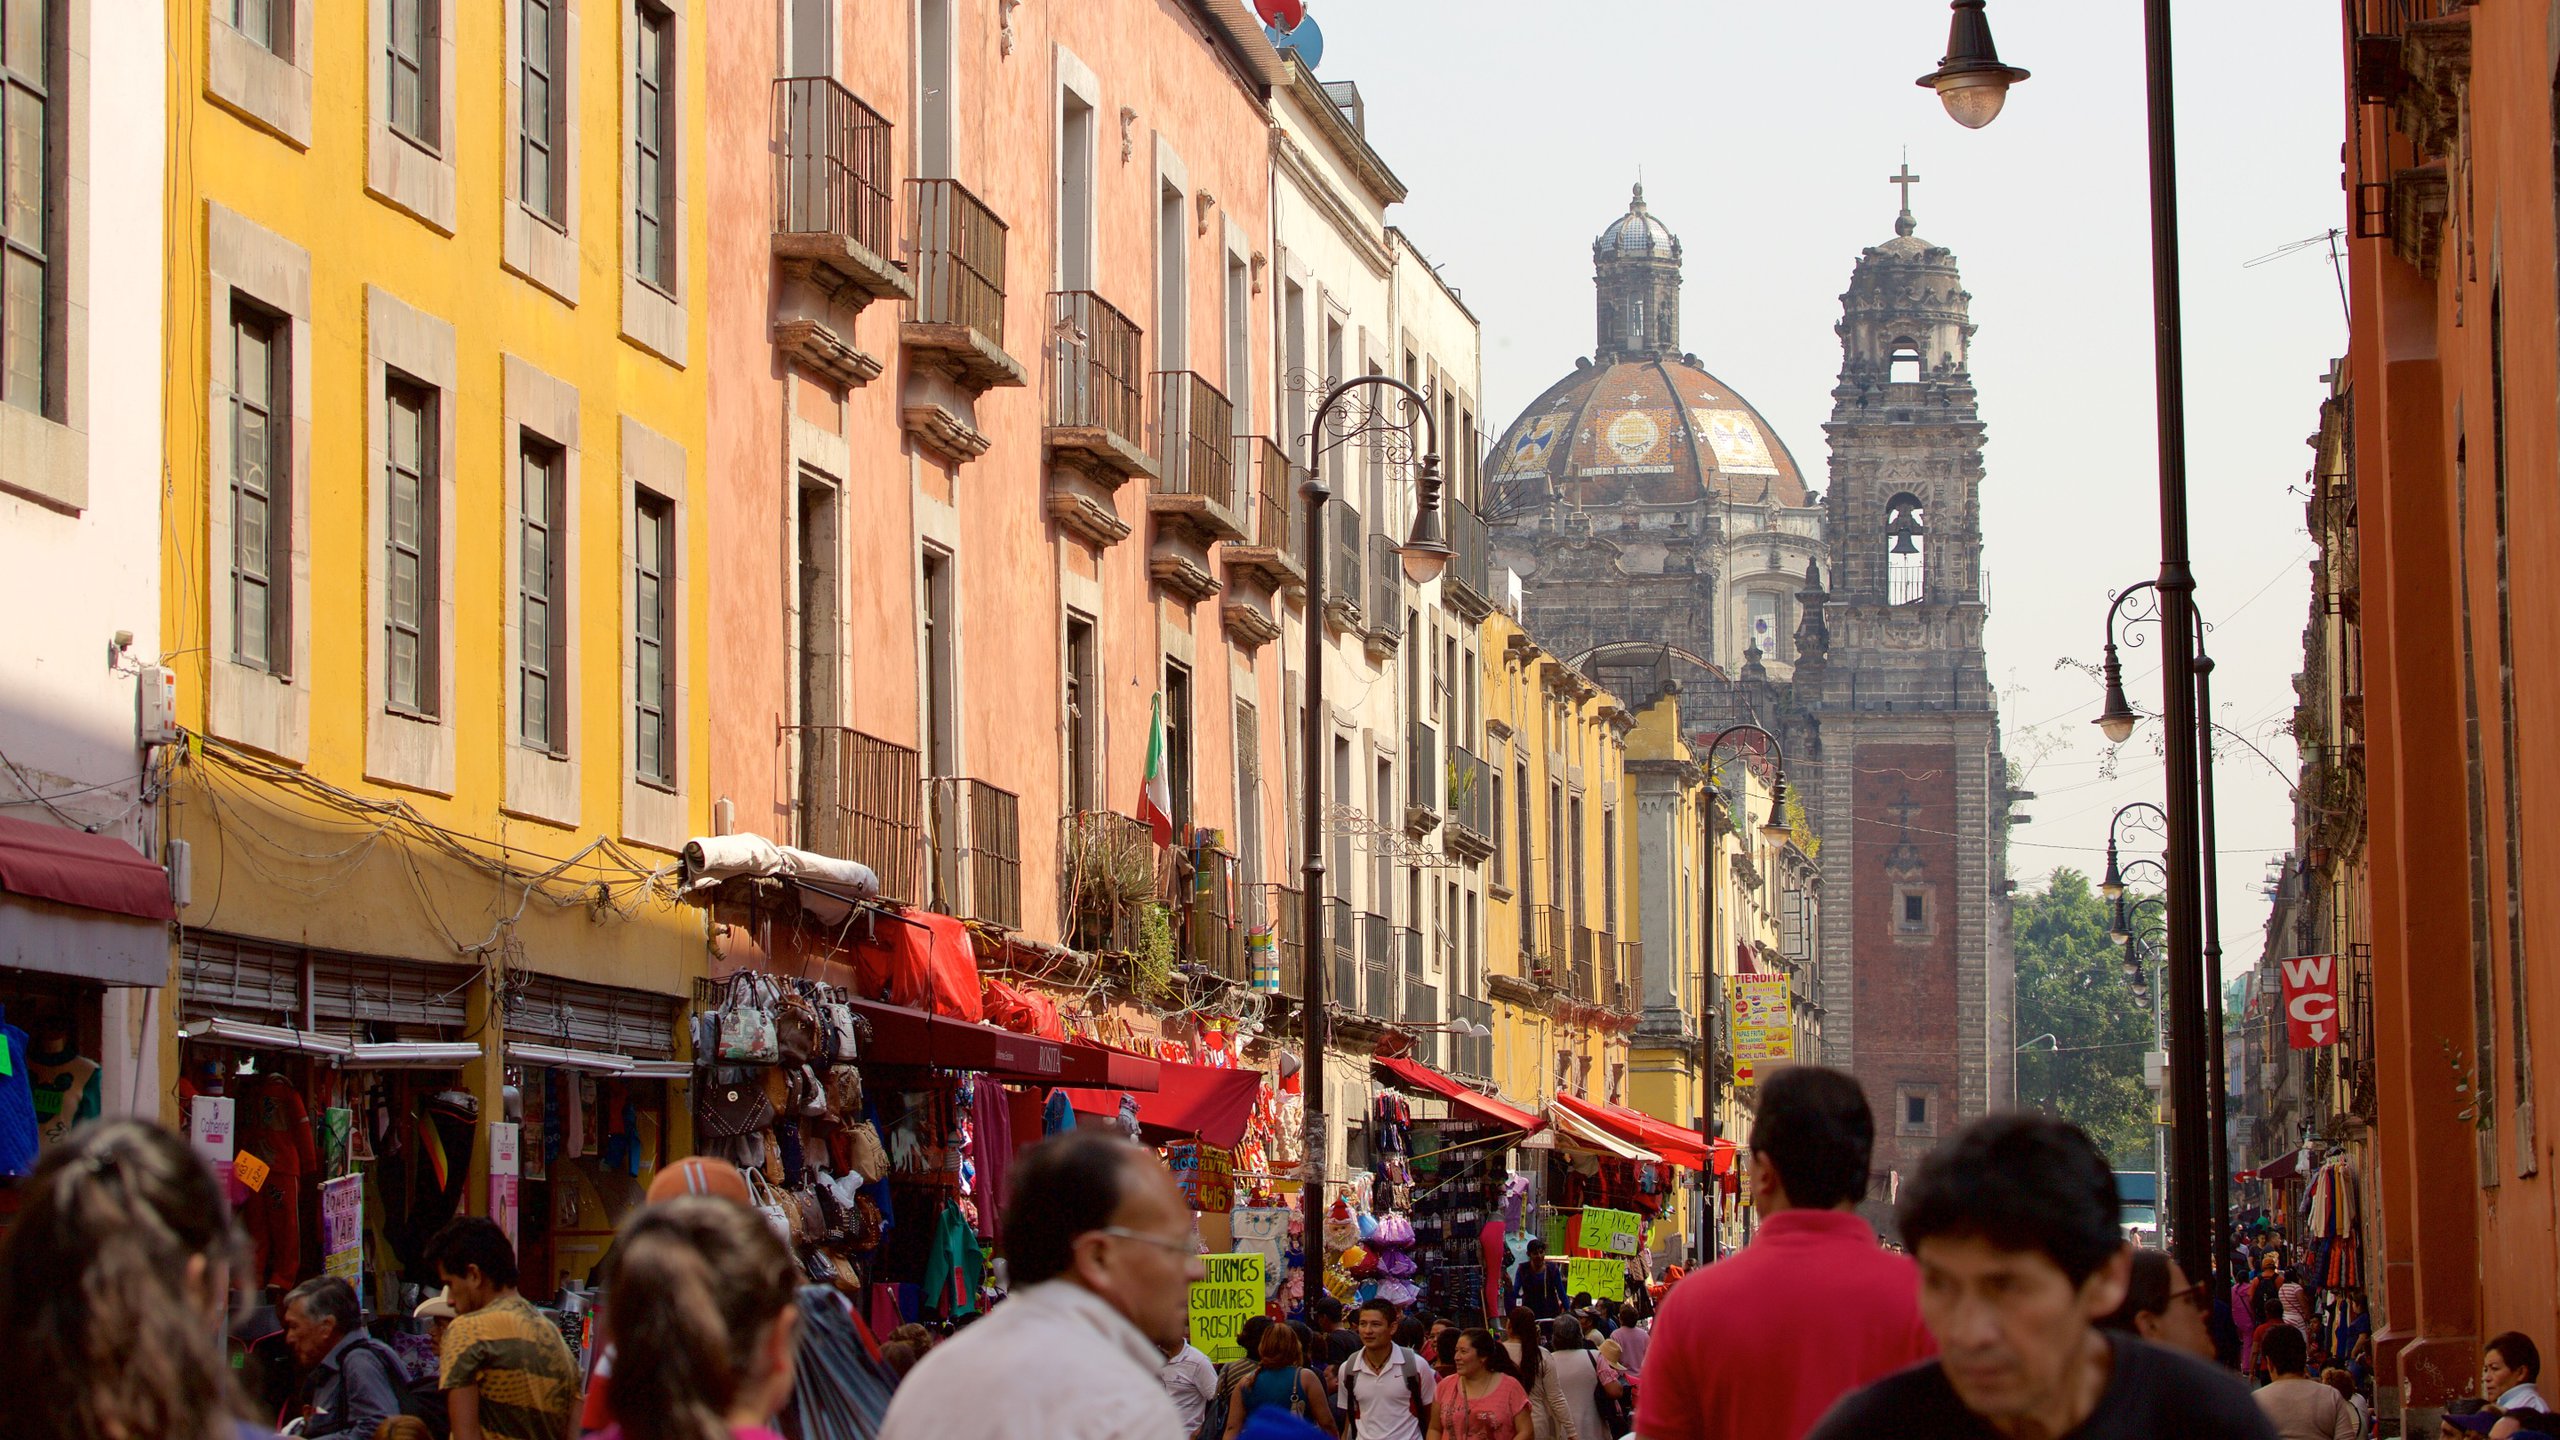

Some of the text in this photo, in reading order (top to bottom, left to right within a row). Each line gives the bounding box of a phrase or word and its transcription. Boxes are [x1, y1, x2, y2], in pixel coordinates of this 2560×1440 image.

[1733, 973, 1785, 985] TIENDITA
[2281, 956, 2336, 1022] WC
[1038, 1045, 1061, 1074] ROSITA
[1190, 1287, 1255, 1310] ESCOLARES
